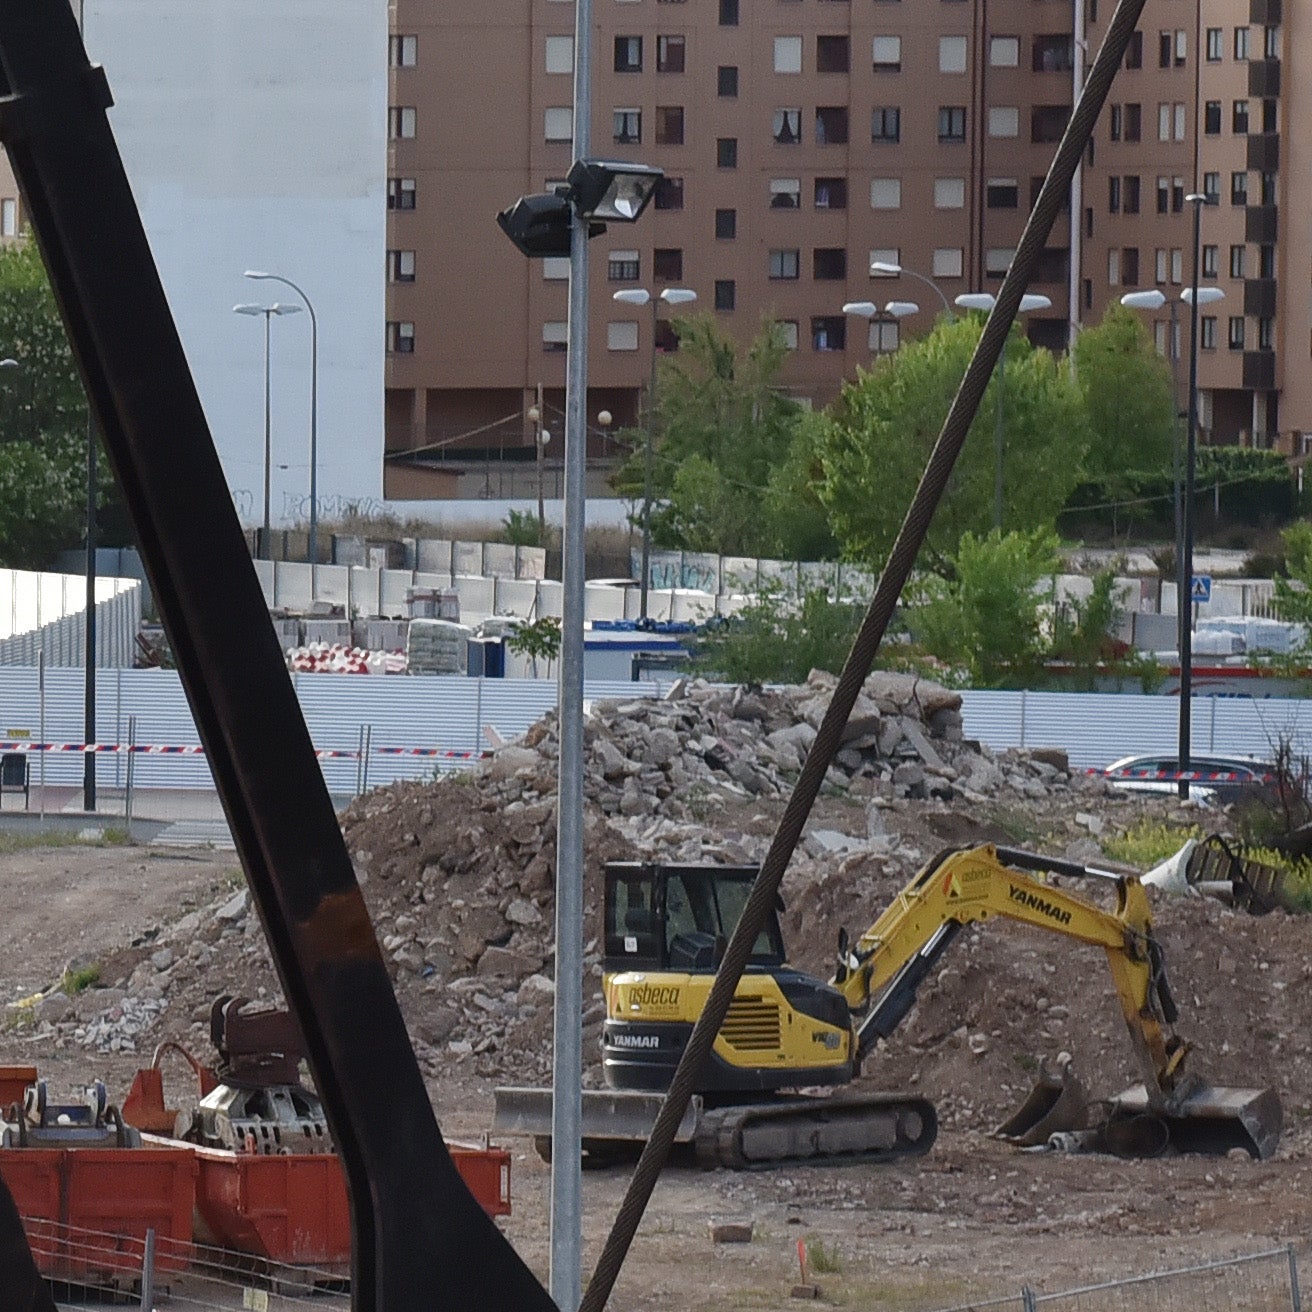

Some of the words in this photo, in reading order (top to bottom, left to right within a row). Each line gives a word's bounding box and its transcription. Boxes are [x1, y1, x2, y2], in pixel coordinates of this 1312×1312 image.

[1009, 883, 1072, 925] YANMAR
[629, 981, 680, 1005] asbeca
[613, 1034, 660, 1048] YANMAR
